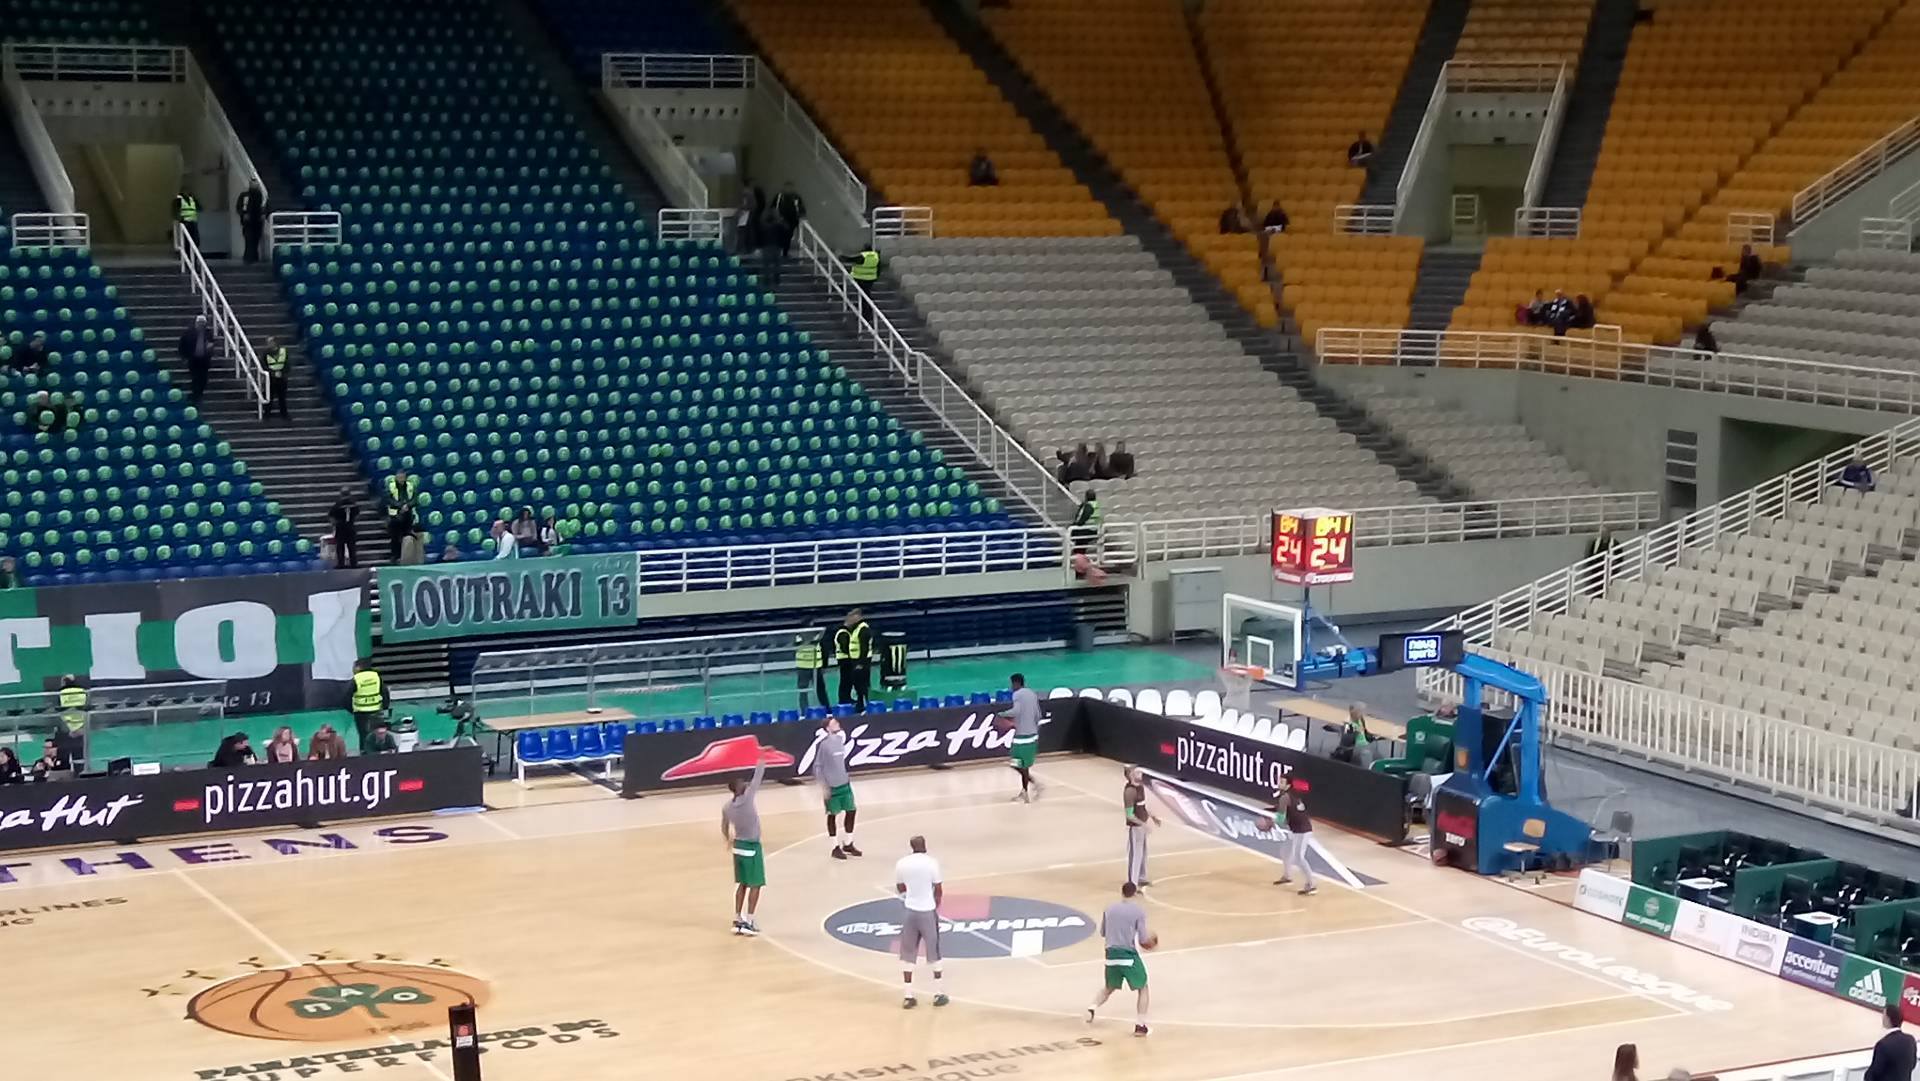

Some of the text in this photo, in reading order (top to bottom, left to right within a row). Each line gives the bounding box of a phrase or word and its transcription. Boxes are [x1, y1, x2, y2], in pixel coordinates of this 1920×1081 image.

[1277, 535, 1302, 565] 24
[1310, 537, 1347, 567] 24
[389, 568, 632, 632] LOUTRAKI 13
[947, 713, 1052, 755] Hu
[205, 768, 397, 823] pizzahut.gr
[40, 794, 144, 831] Hut
[1784, 951, 1840, 979] accenture
[1848, 986, 1887, 1007] adidas
[927, 1036, 1102, 1069] AIRLINES
